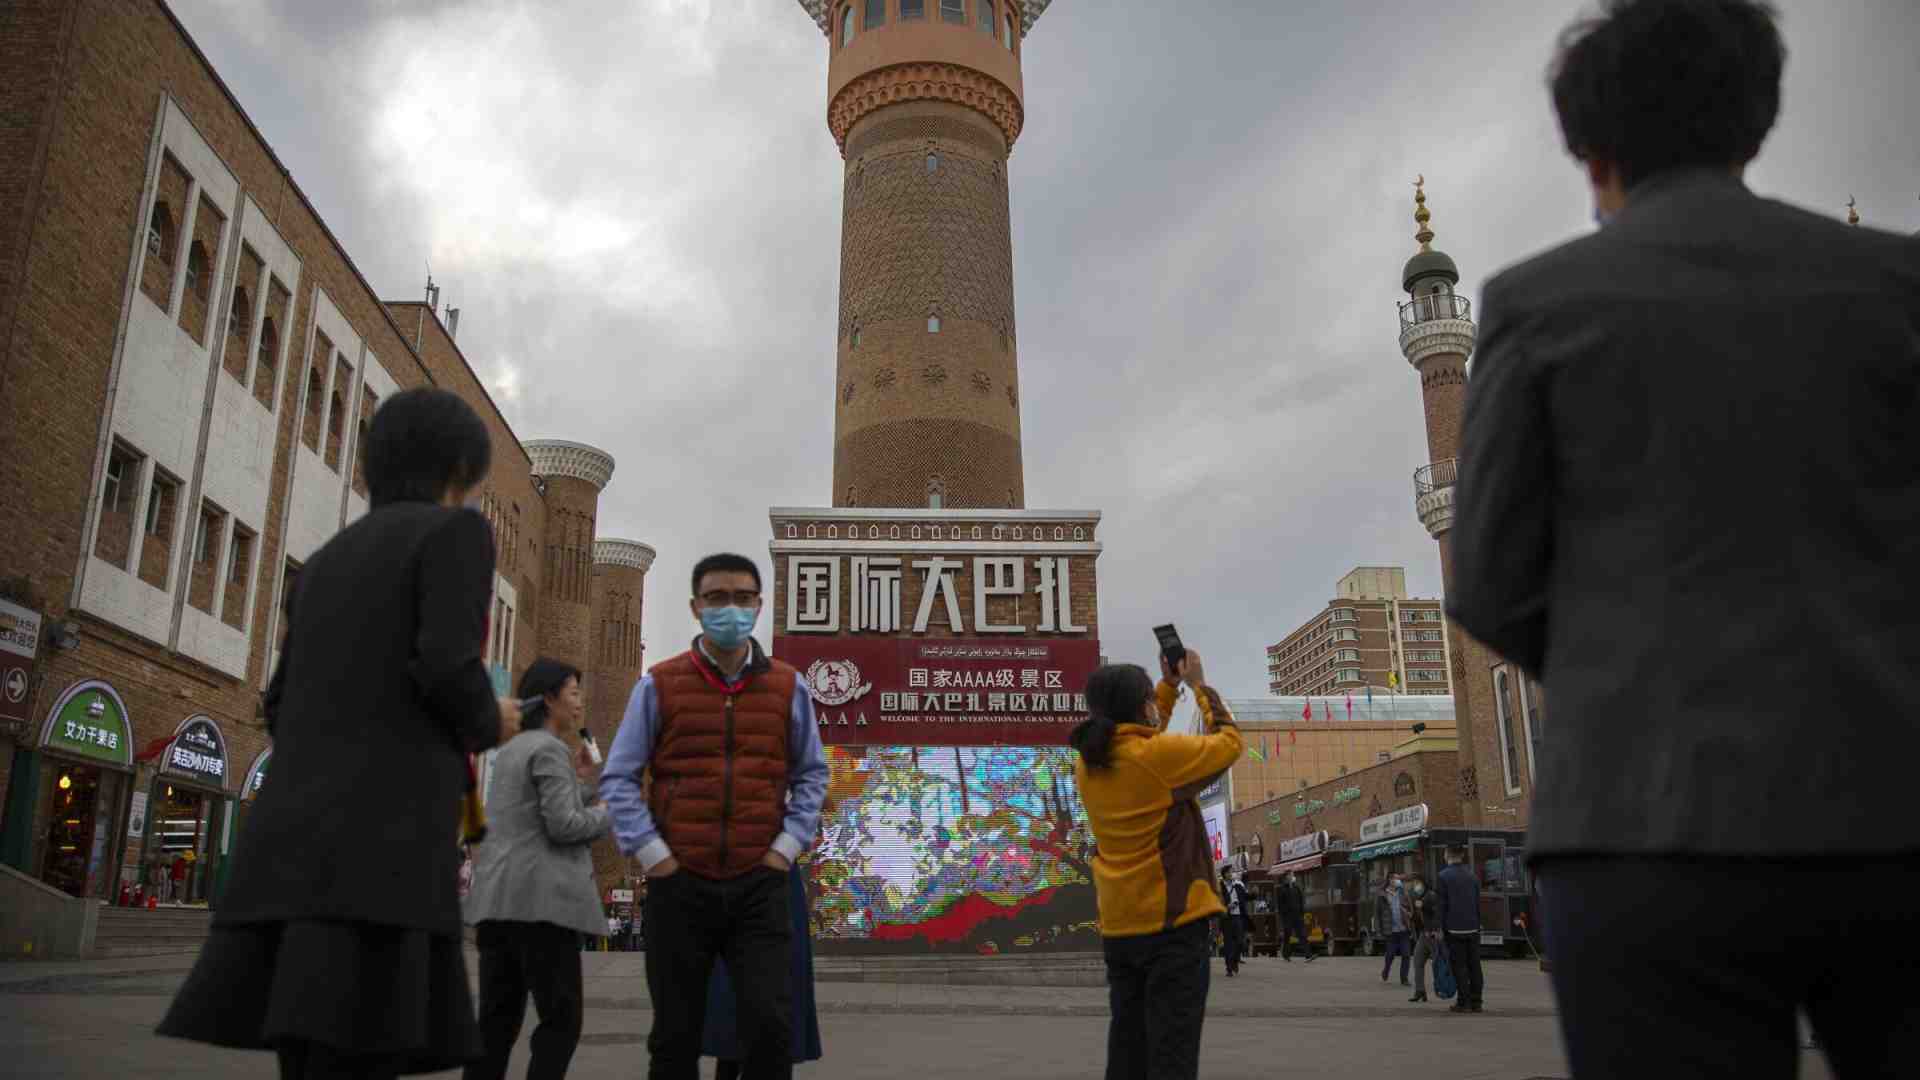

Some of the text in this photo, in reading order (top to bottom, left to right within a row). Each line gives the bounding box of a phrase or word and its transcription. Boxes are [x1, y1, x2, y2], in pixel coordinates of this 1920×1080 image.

[786, 555, 1087, 632] 国际大巴扎
[909, 668, 1063, 688] 国家AAAA级景区
[880, 714, 920, 723] WELCOME
[924, 714, 935, 723] TO
[939, 714, 955, 723] THE
[959, 714, 1021, 723] INTERNATIONAL
[1024, 714, 1054, 723] GRAND
